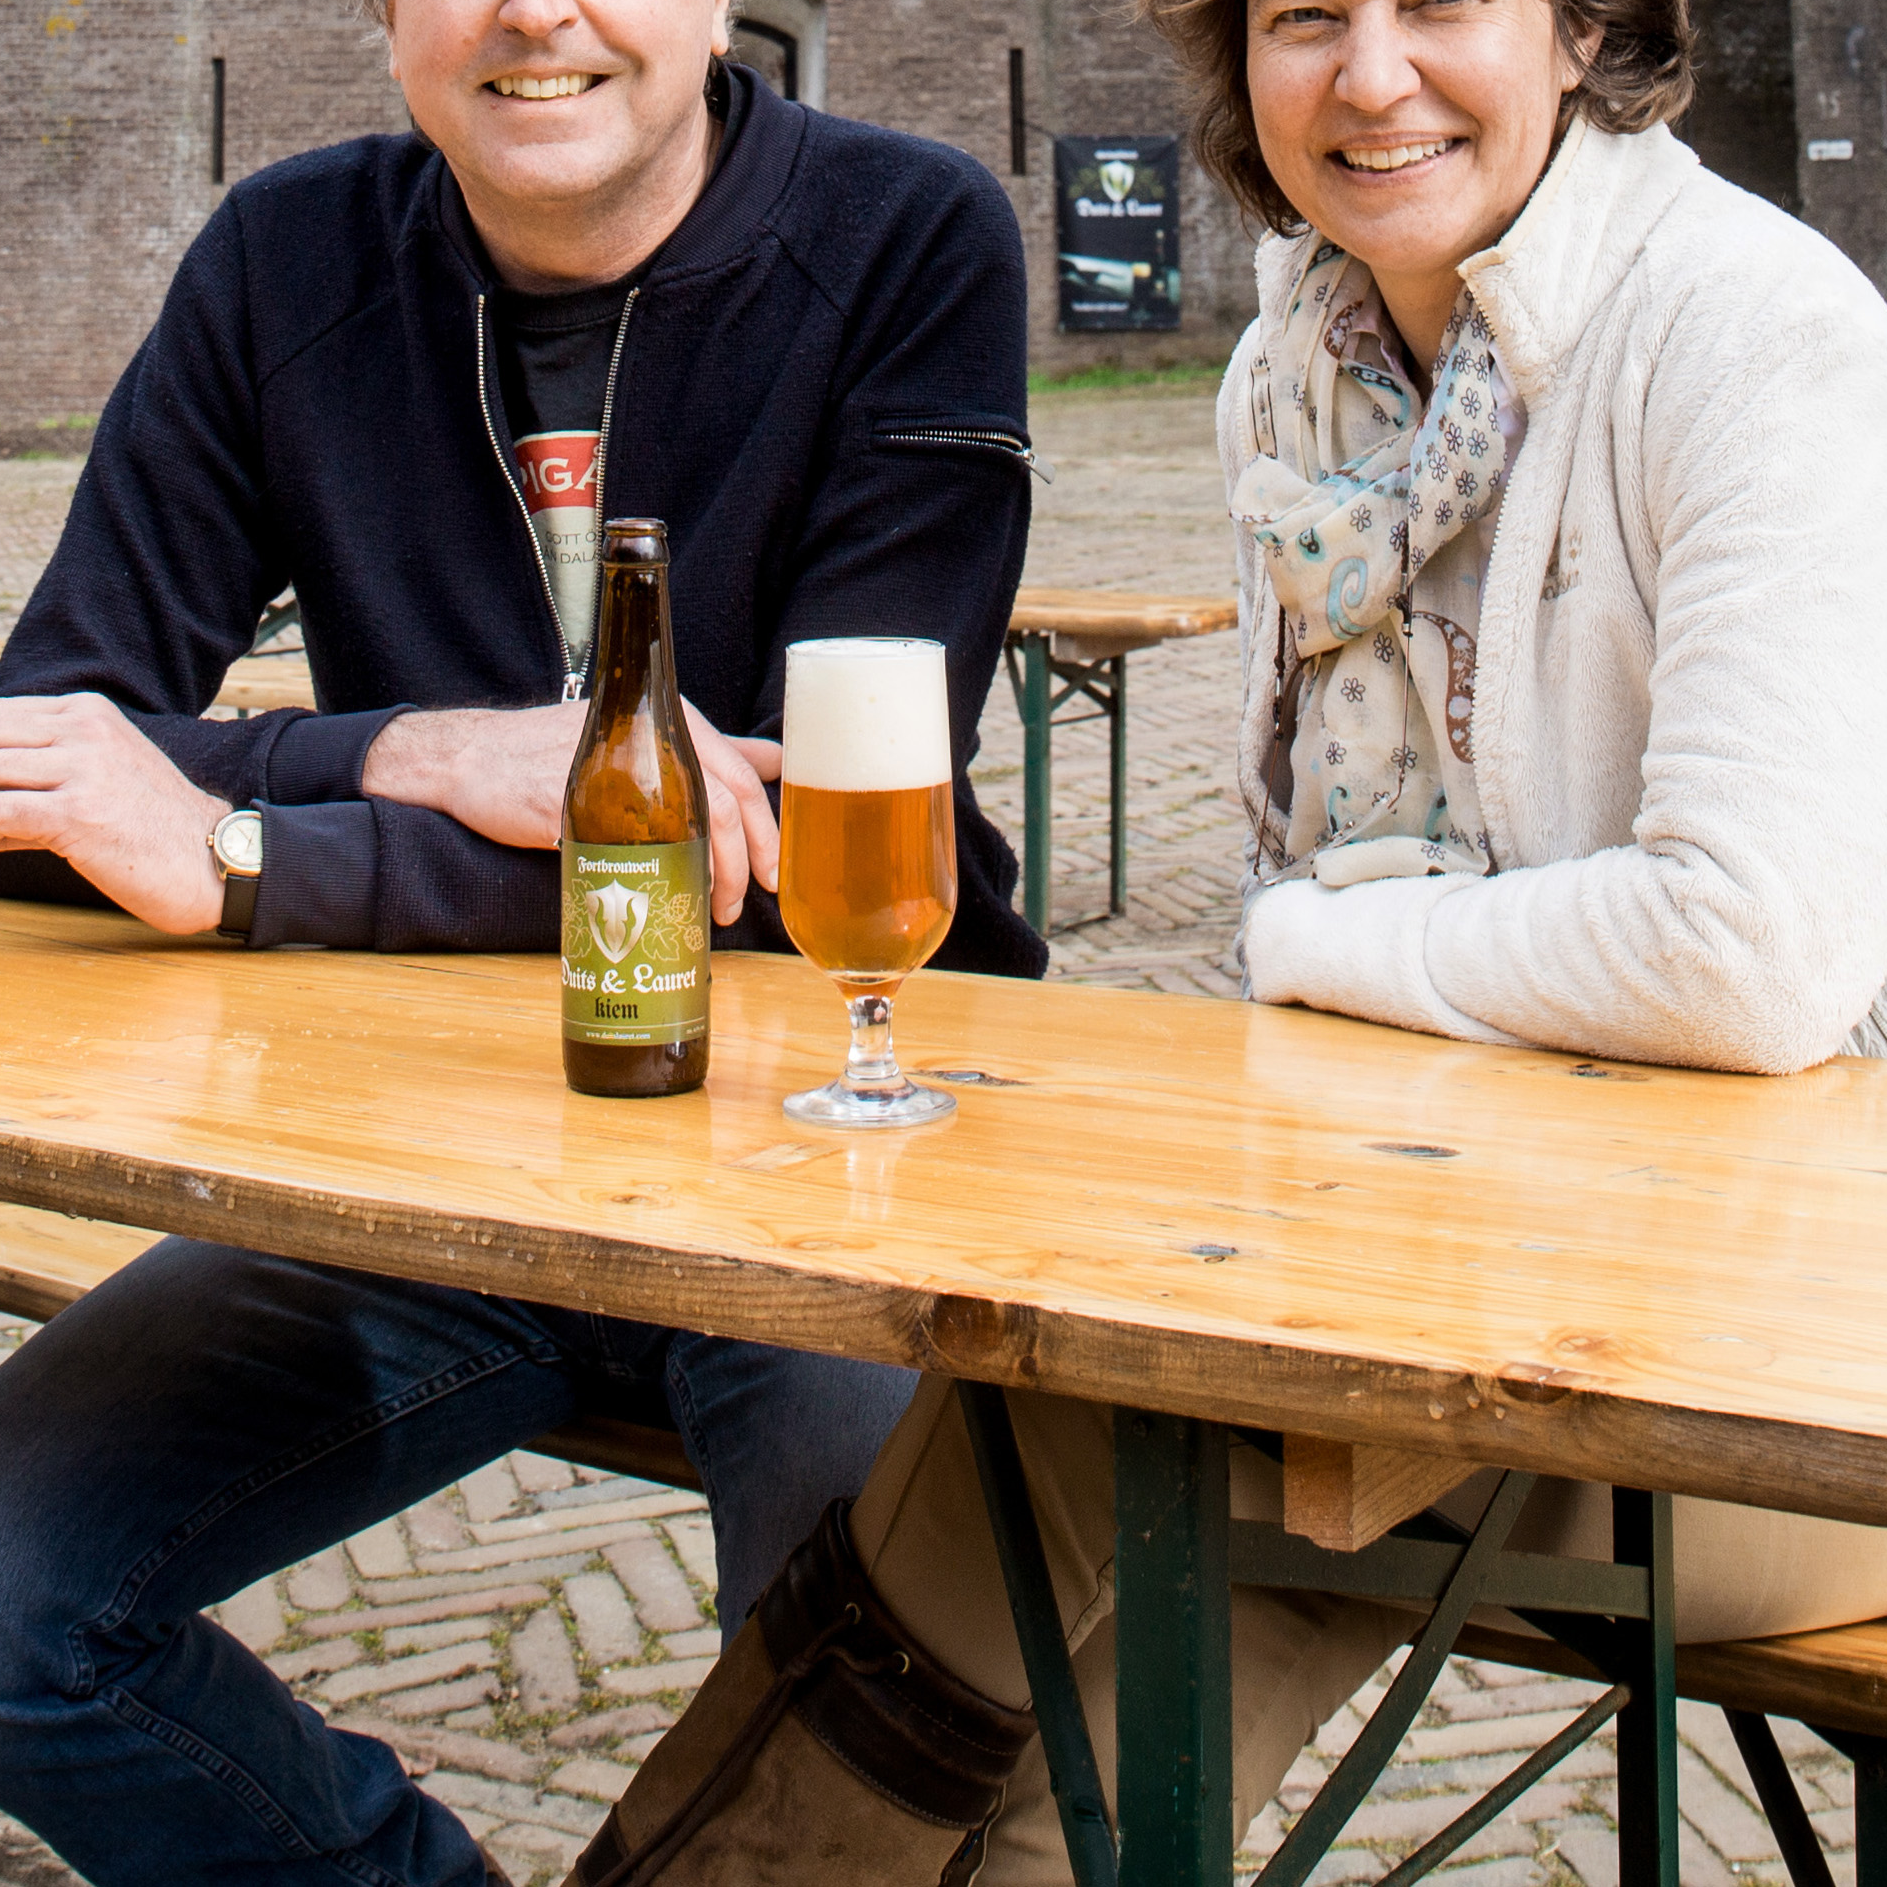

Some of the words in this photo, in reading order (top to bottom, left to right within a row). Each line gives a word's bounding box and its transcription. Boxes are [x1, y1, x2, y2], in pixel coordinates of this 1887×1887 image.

[577, 855, 660, 876] Fortbrouwerij
[601, 968, 627, 994] &
[632, 963, 697, 994] Lauret
[595, 996, 639, 1019] kiem
